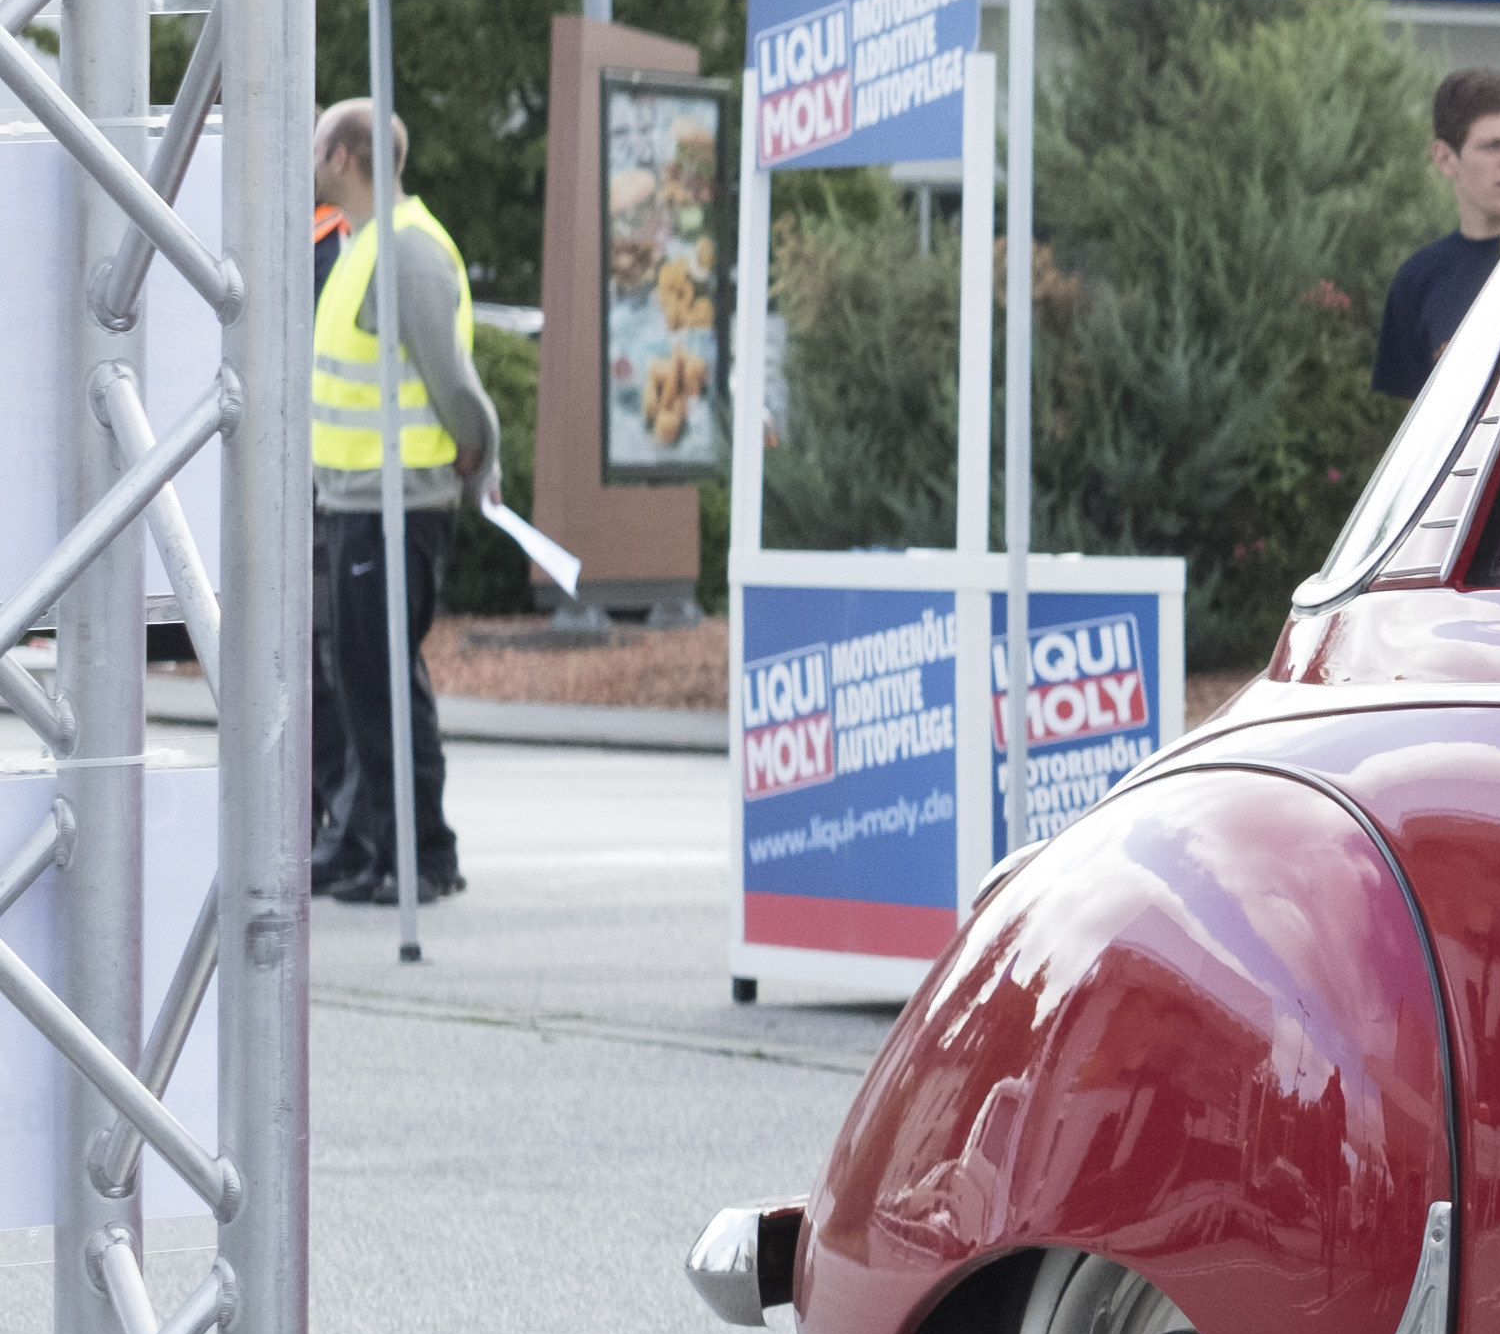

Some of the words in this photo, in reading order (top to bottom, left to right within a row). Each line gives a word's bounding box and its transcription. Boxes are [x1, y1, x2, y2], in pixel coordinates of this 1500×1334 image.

[760, 10, 846, 95] LIQUI
[854, 12, 937, 85] ADDITIVE
[762, 70, 849, 158] MOLY
[855, 46, 965, 131] AUTOPFLEGE
[744, 652, 827, 728] LIQUI
[834, 667, 925, 730] ADDITIVE
[746, 715, 830, 791] MOLY
[837, 703, 955, 776] AUTOPFLEGE
[748, 787, 953, 864] www.liqui-moly.de
